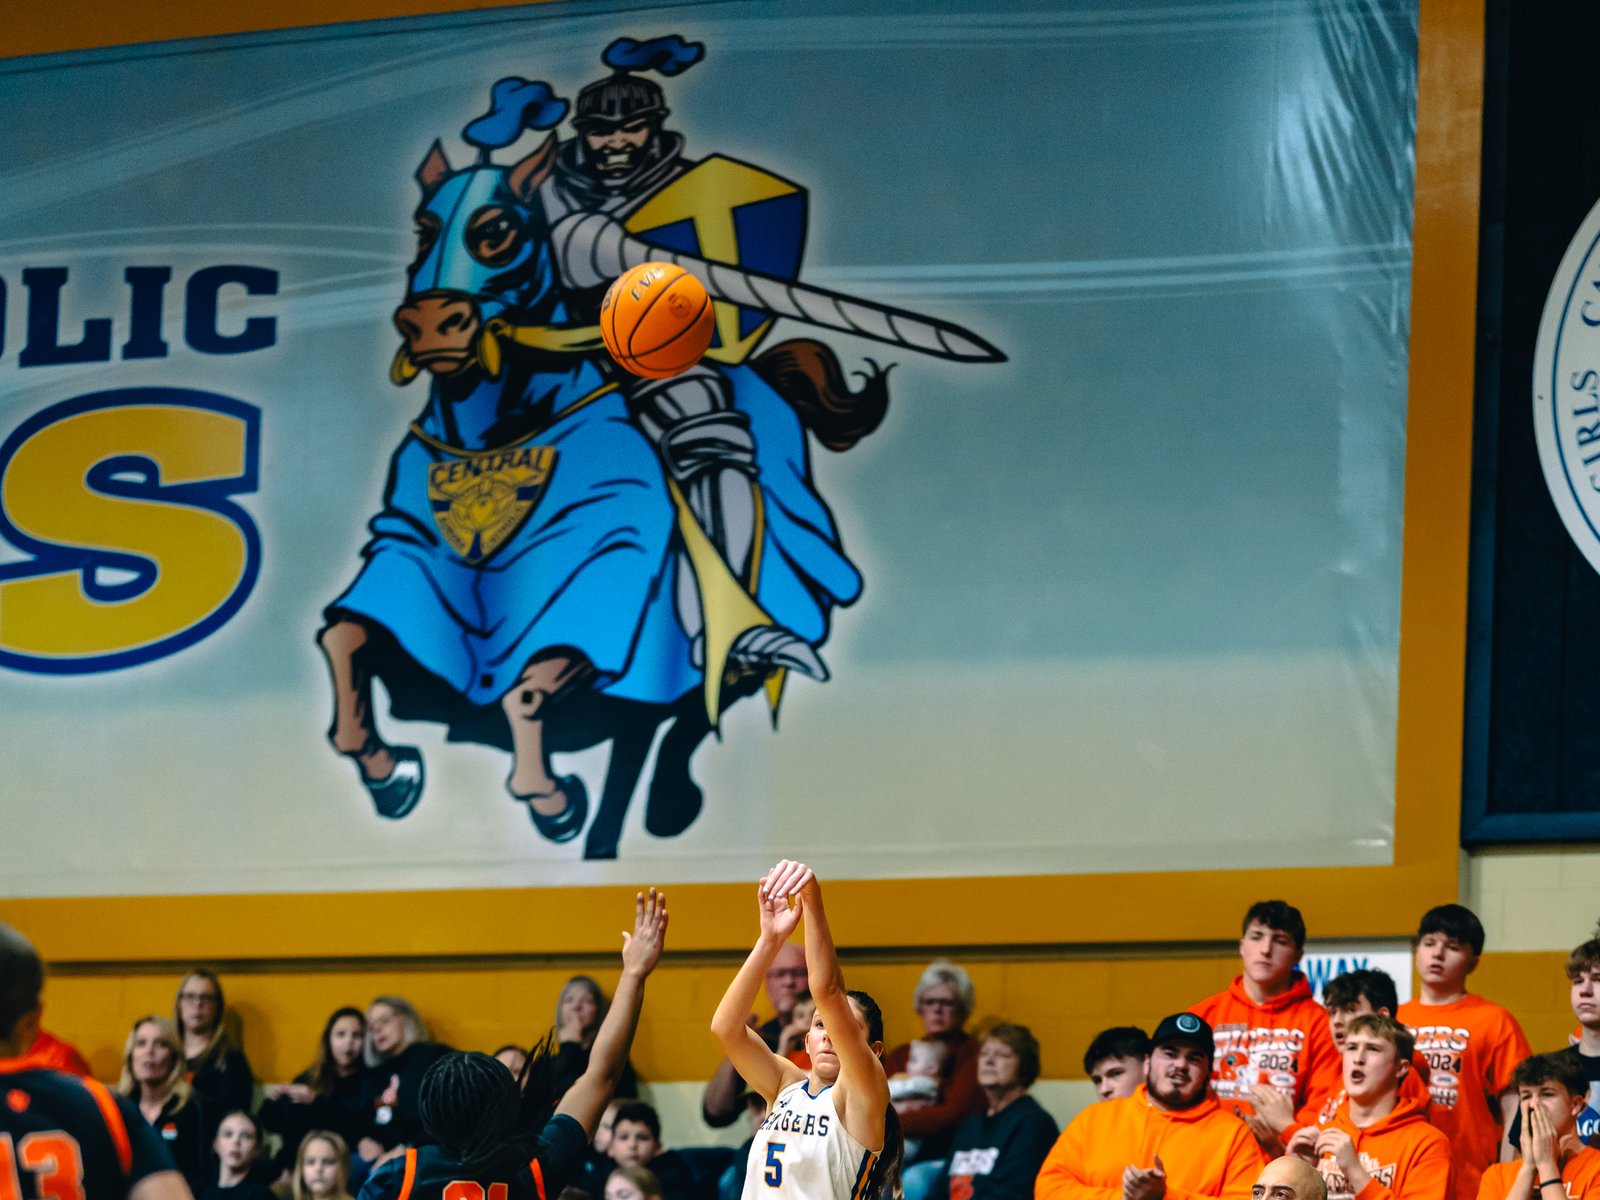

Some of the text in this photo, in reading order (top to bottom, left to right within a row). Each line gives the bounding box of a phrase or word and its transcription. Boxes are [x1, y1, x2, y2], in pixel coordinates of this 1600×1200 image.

[0, 265, 280, 369] LIC
[0, 386, 262, 677] S
[1292, 957, 1367, 996] WAY
[1259, 1053, 1299, 1073] 2024
[764, 1141, 786, 1189] 5
